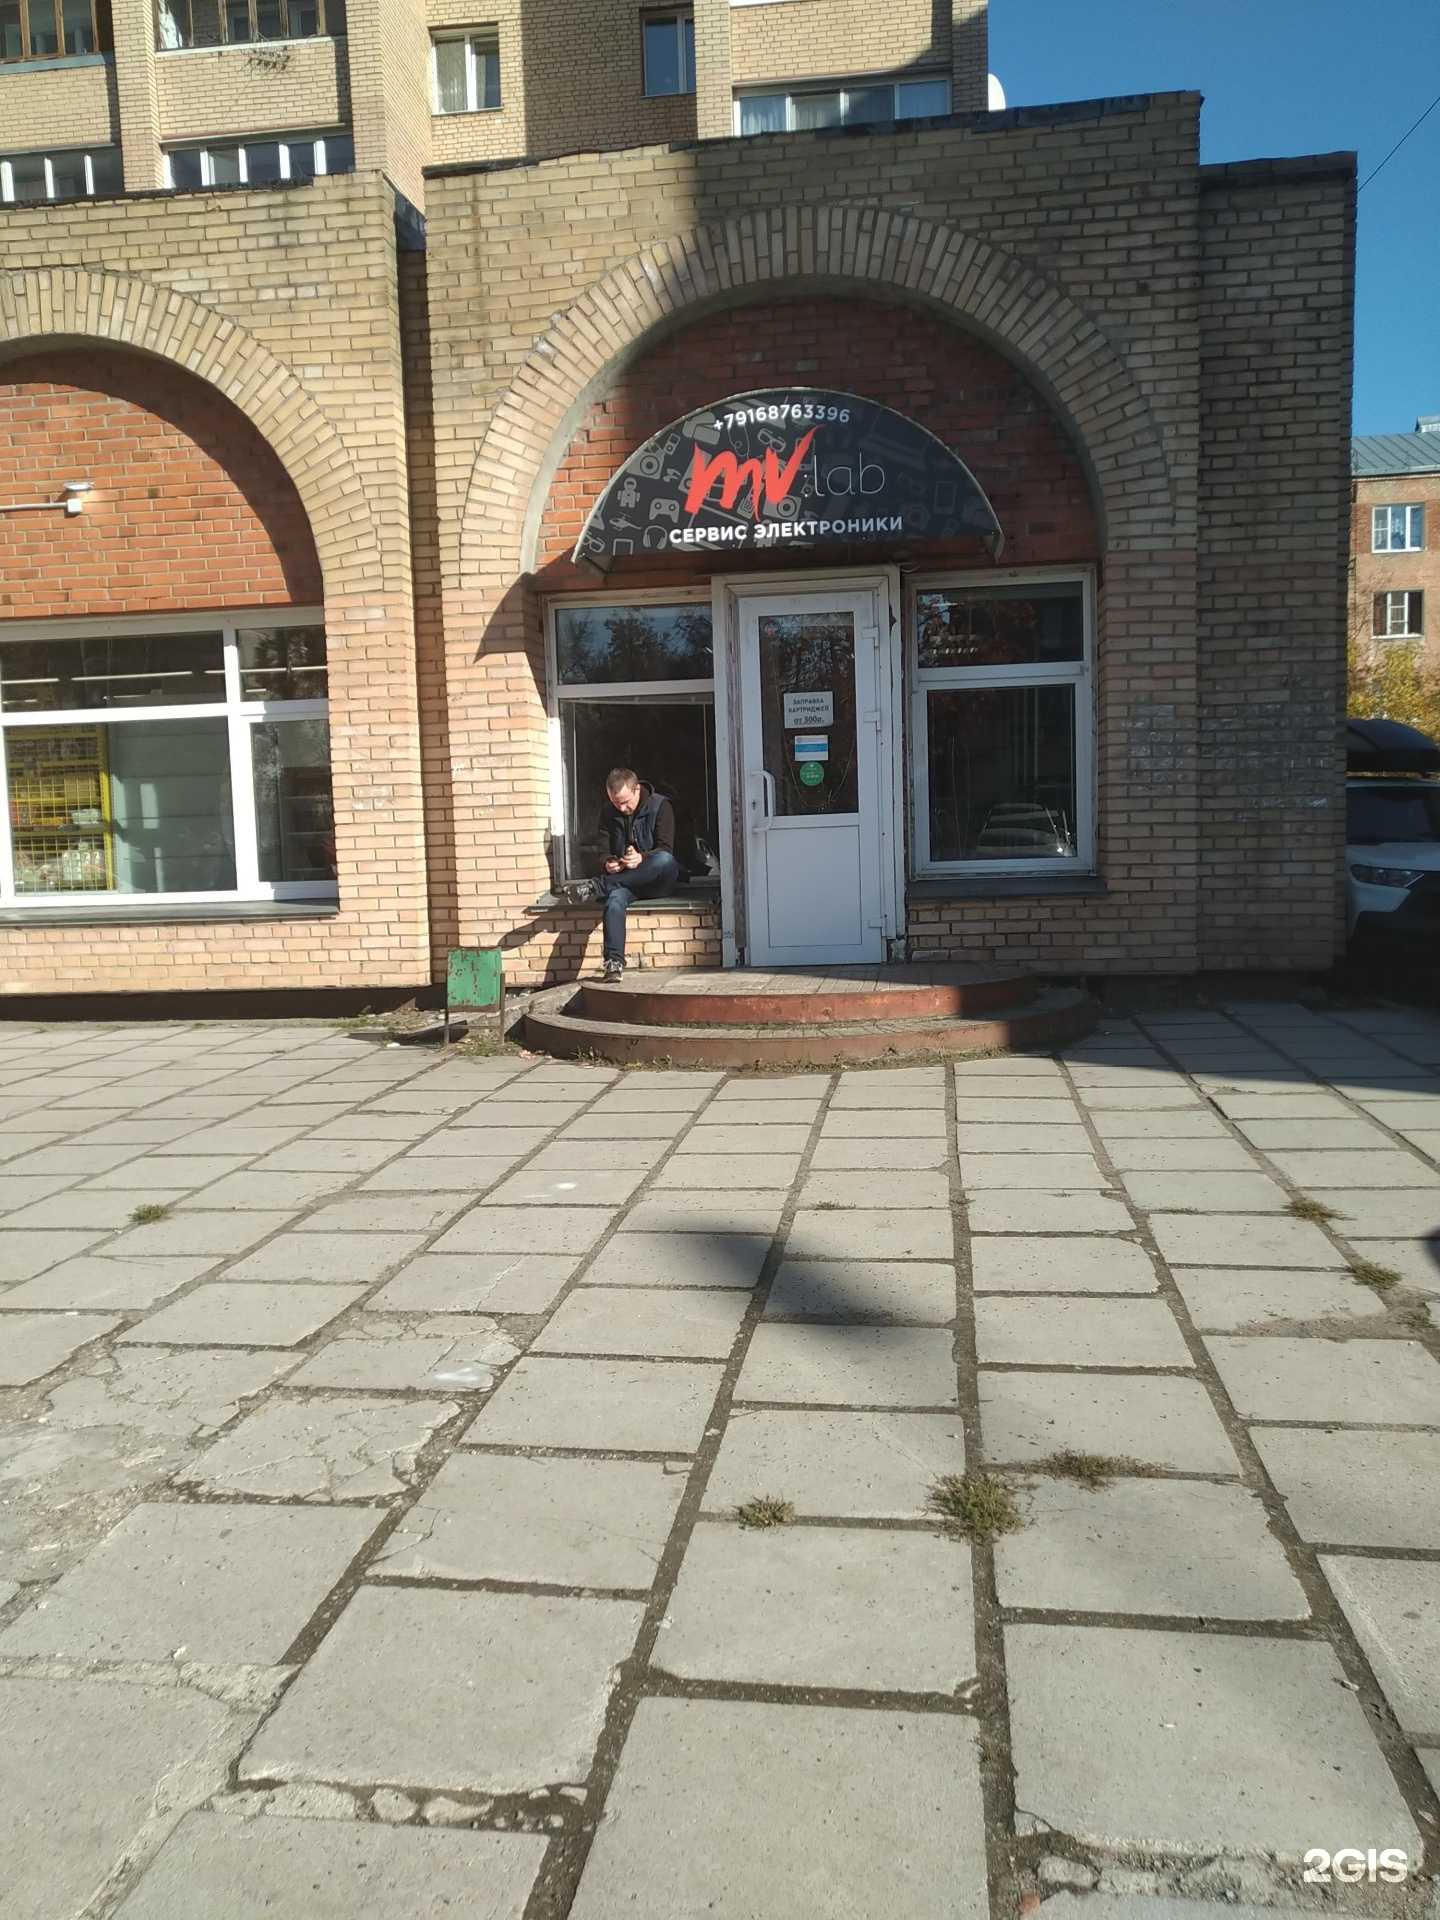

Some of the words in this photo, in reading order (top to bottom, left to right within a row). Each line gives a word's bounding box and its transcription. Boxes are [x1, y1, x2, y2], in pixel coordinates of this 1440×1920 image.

[713, 404, 850, 431] +79168763396
[669, 525, 747, 543] СЕРВИС
[753, 517, 903, 538] ЭЛЕКТРОНИКИ
[788, 705, 829, 713] КАРТРИДЖЕЙ
[793, 697, 824, 705] ЗАПРАВКА
